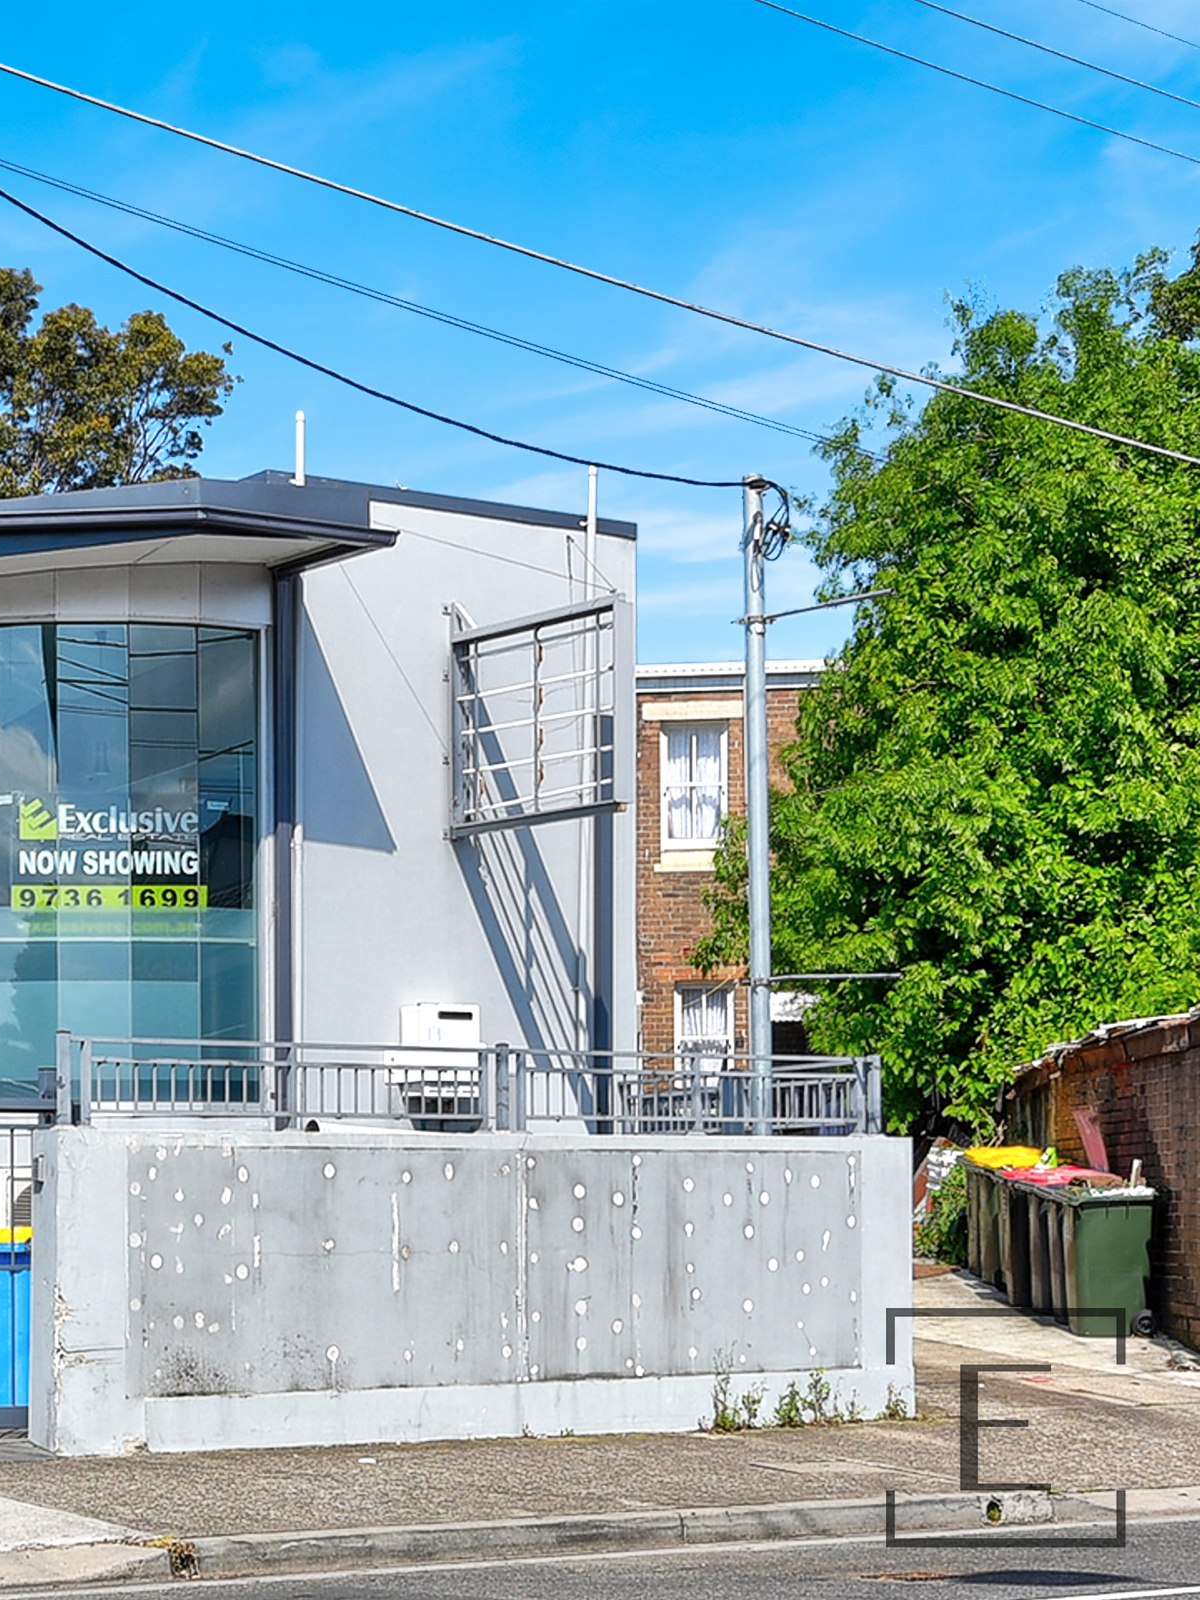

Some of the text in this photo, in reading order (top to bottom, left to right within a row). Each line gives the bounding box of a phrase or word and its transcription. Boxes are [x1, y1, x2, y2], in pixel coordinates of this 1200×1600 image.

[59, 803, 199, 834] Exclusive
[19, 850, 200, 875] NOW SHOWING
[19, 888, 199, 908] 9736 1699
